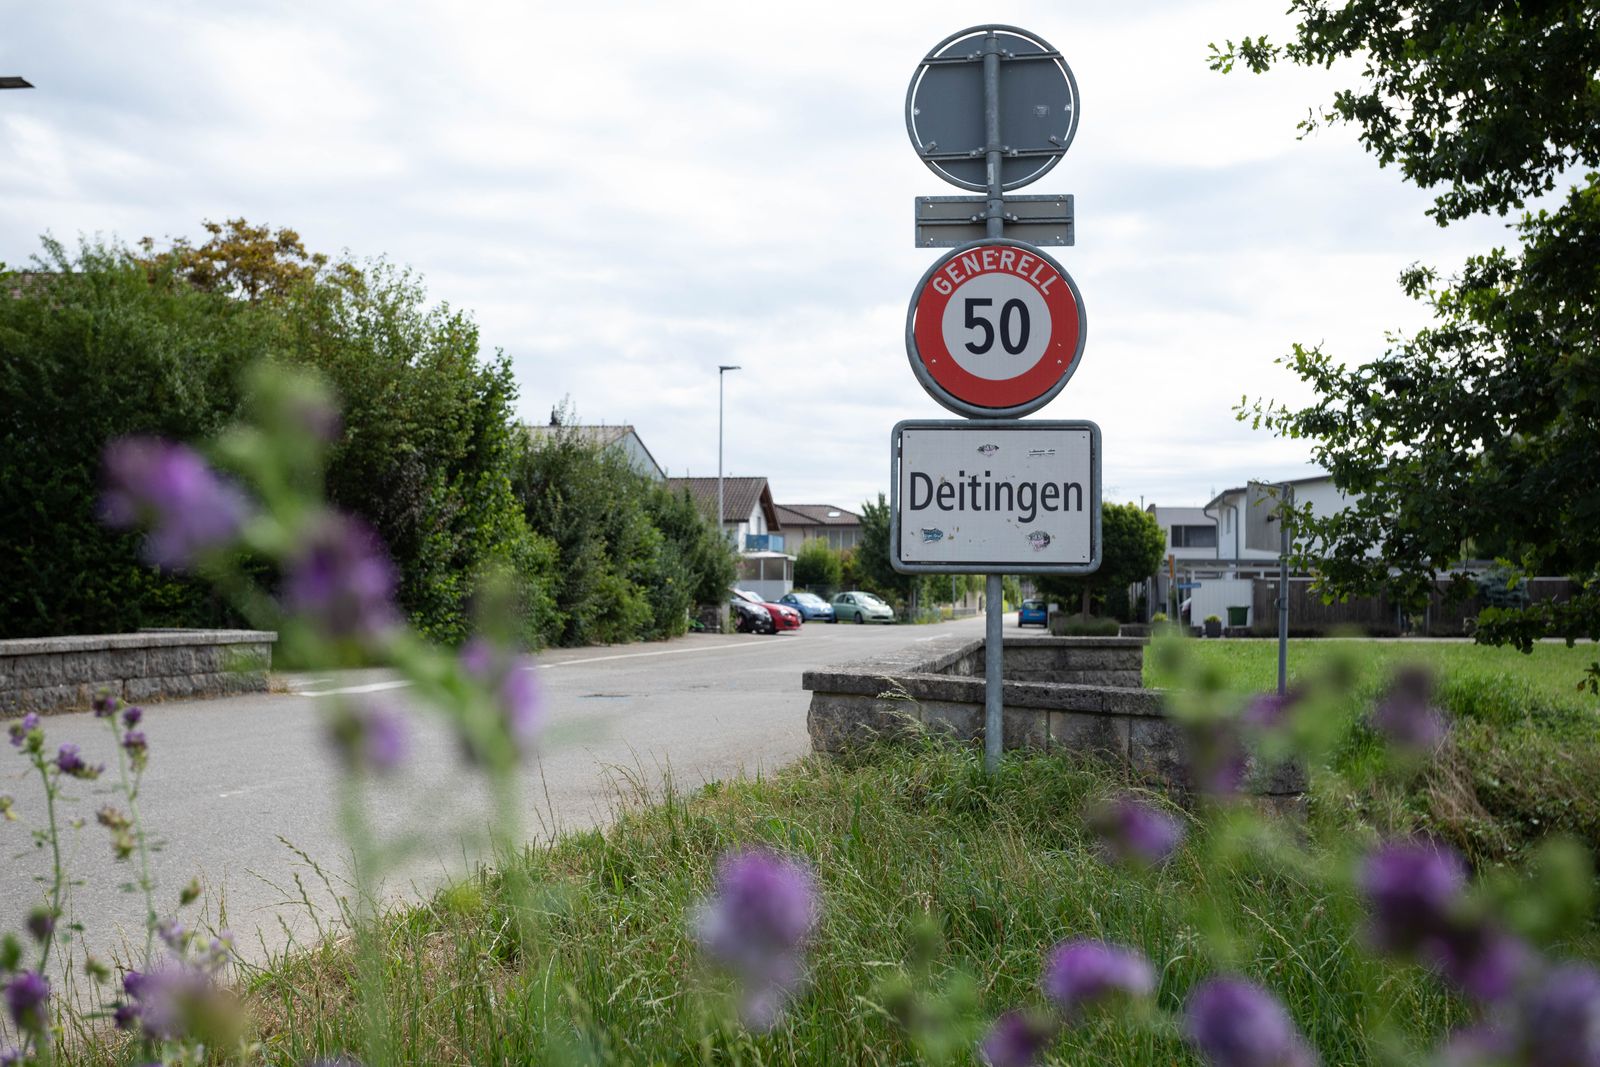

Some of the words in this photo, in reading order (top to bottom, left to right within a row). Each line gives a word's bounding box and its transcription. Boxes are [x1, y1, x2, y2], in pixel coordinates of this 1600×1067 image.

[932, 250, 1057, 295] GENERELL
[965, 298, 1030, 355] 50
[910, 470, 1083, 523] Deitingen
